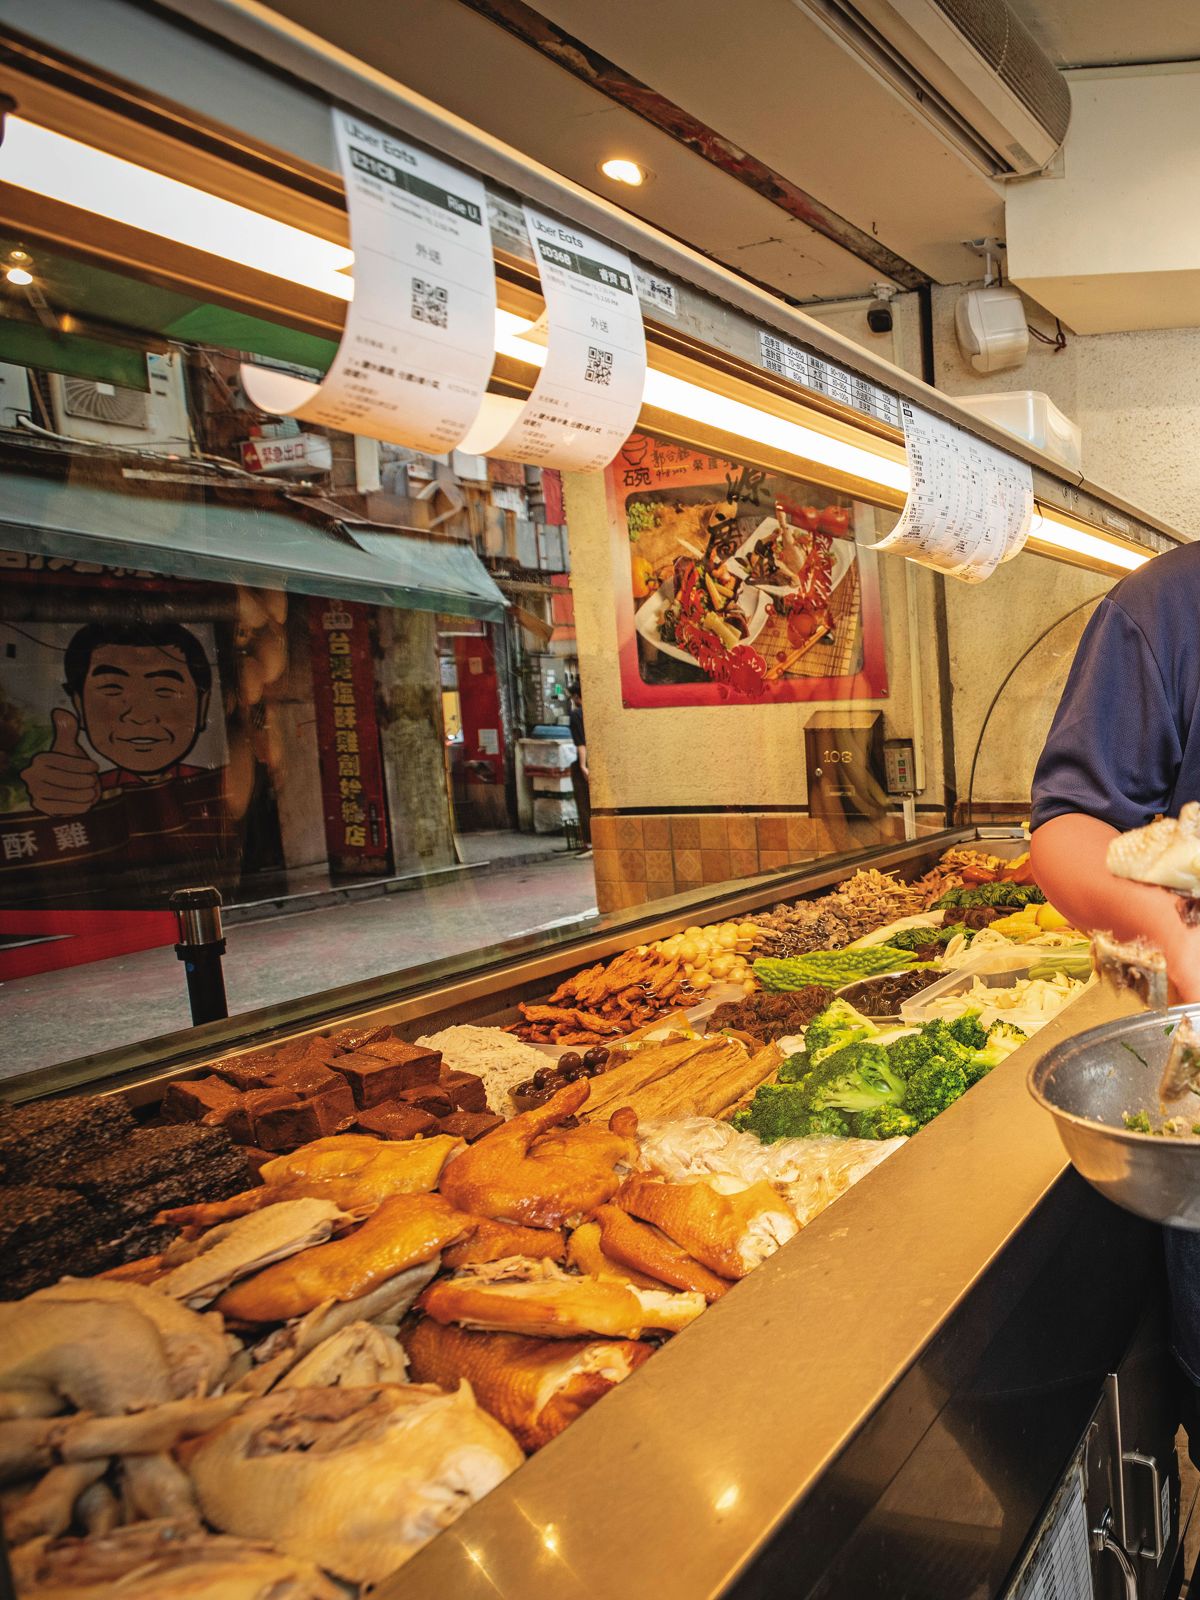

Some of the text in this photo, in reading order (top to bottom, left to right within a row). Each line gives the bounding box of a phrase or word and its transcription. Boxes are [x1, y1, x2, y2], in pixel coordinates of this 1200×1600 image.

[344, 120, 418, 166] Uber Eats
[531, 217, 556, 237] Uber
[558, 229, 584, 249] Eats
[623, 467, 652, 488] 碗
